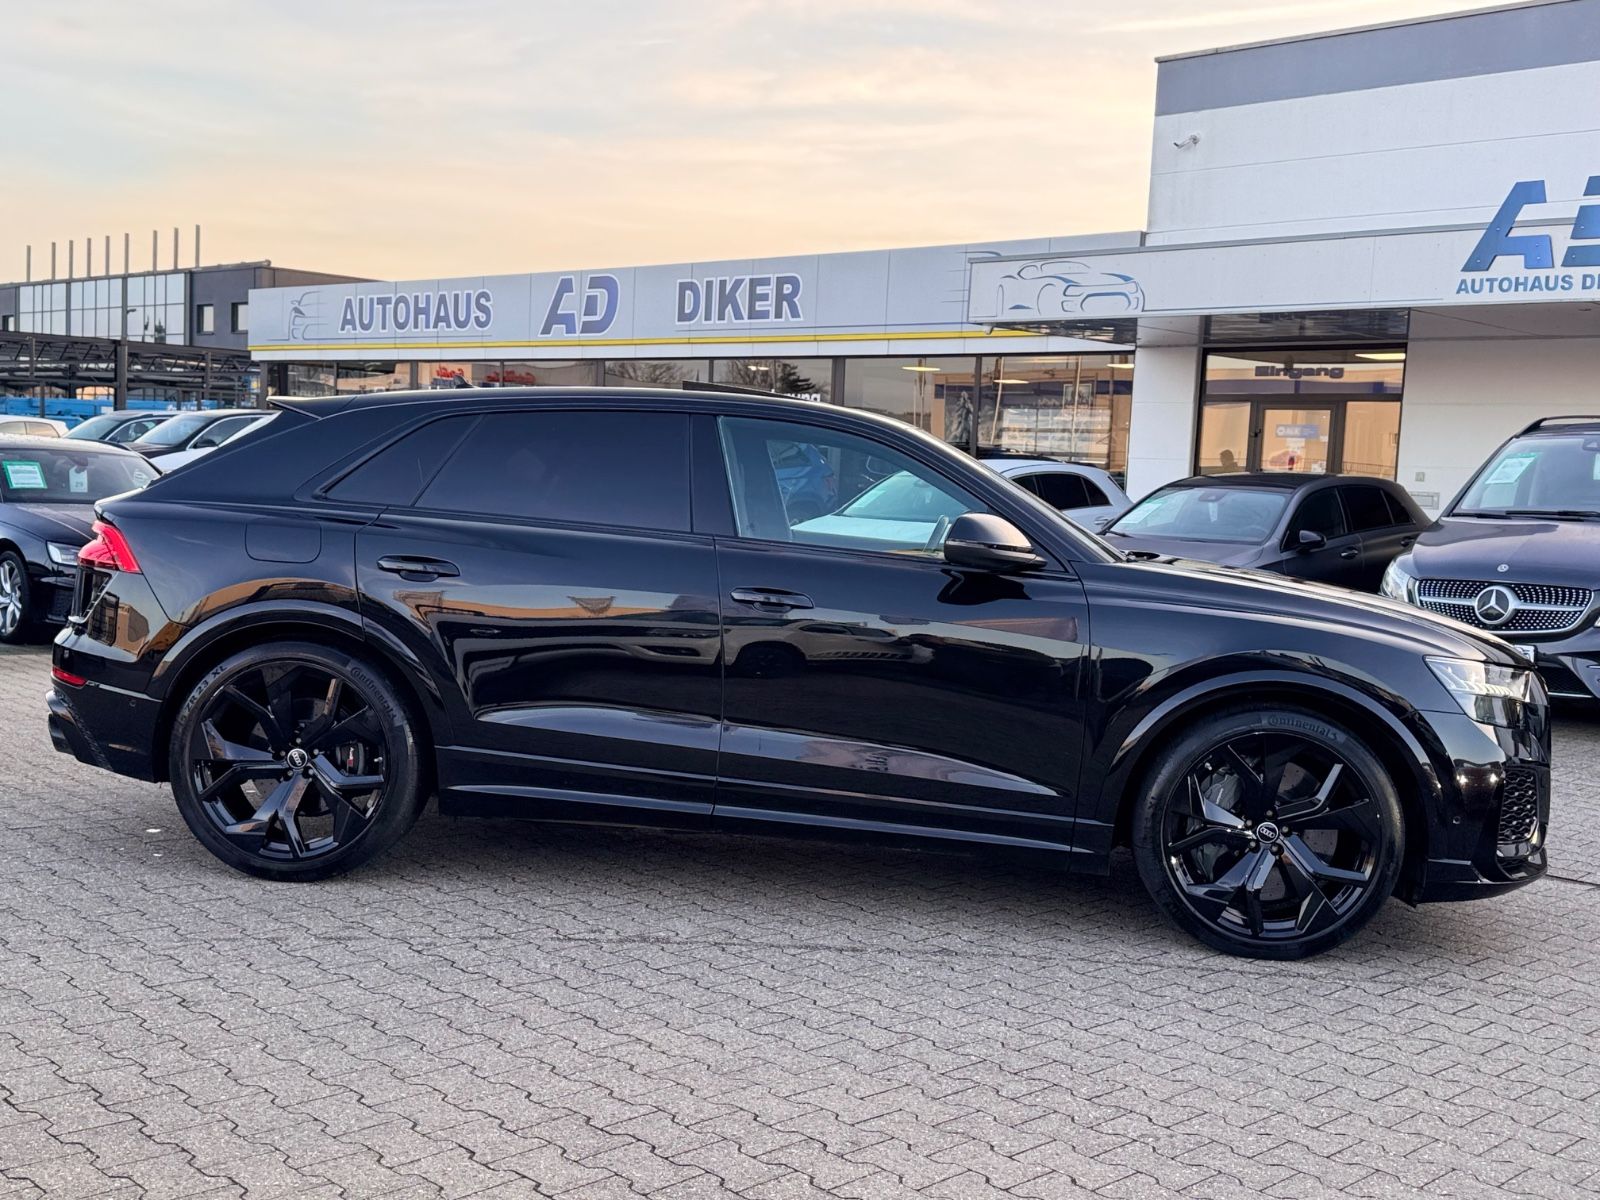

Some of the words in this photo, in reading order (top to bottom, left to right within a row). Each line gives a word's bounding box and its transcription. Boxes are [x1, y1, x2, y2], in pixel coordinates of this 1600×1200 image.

[1456, 274, 1573, 294] AUTOHAUS
[339, 290, 492, 332] AUTOHAUS
[539, 275, 619, 335] AD
[676, 274, 802, 324] DIKER
[1255, 366, 1344, 379] Eingang
[1267, 714, 1330, 738] Continental
